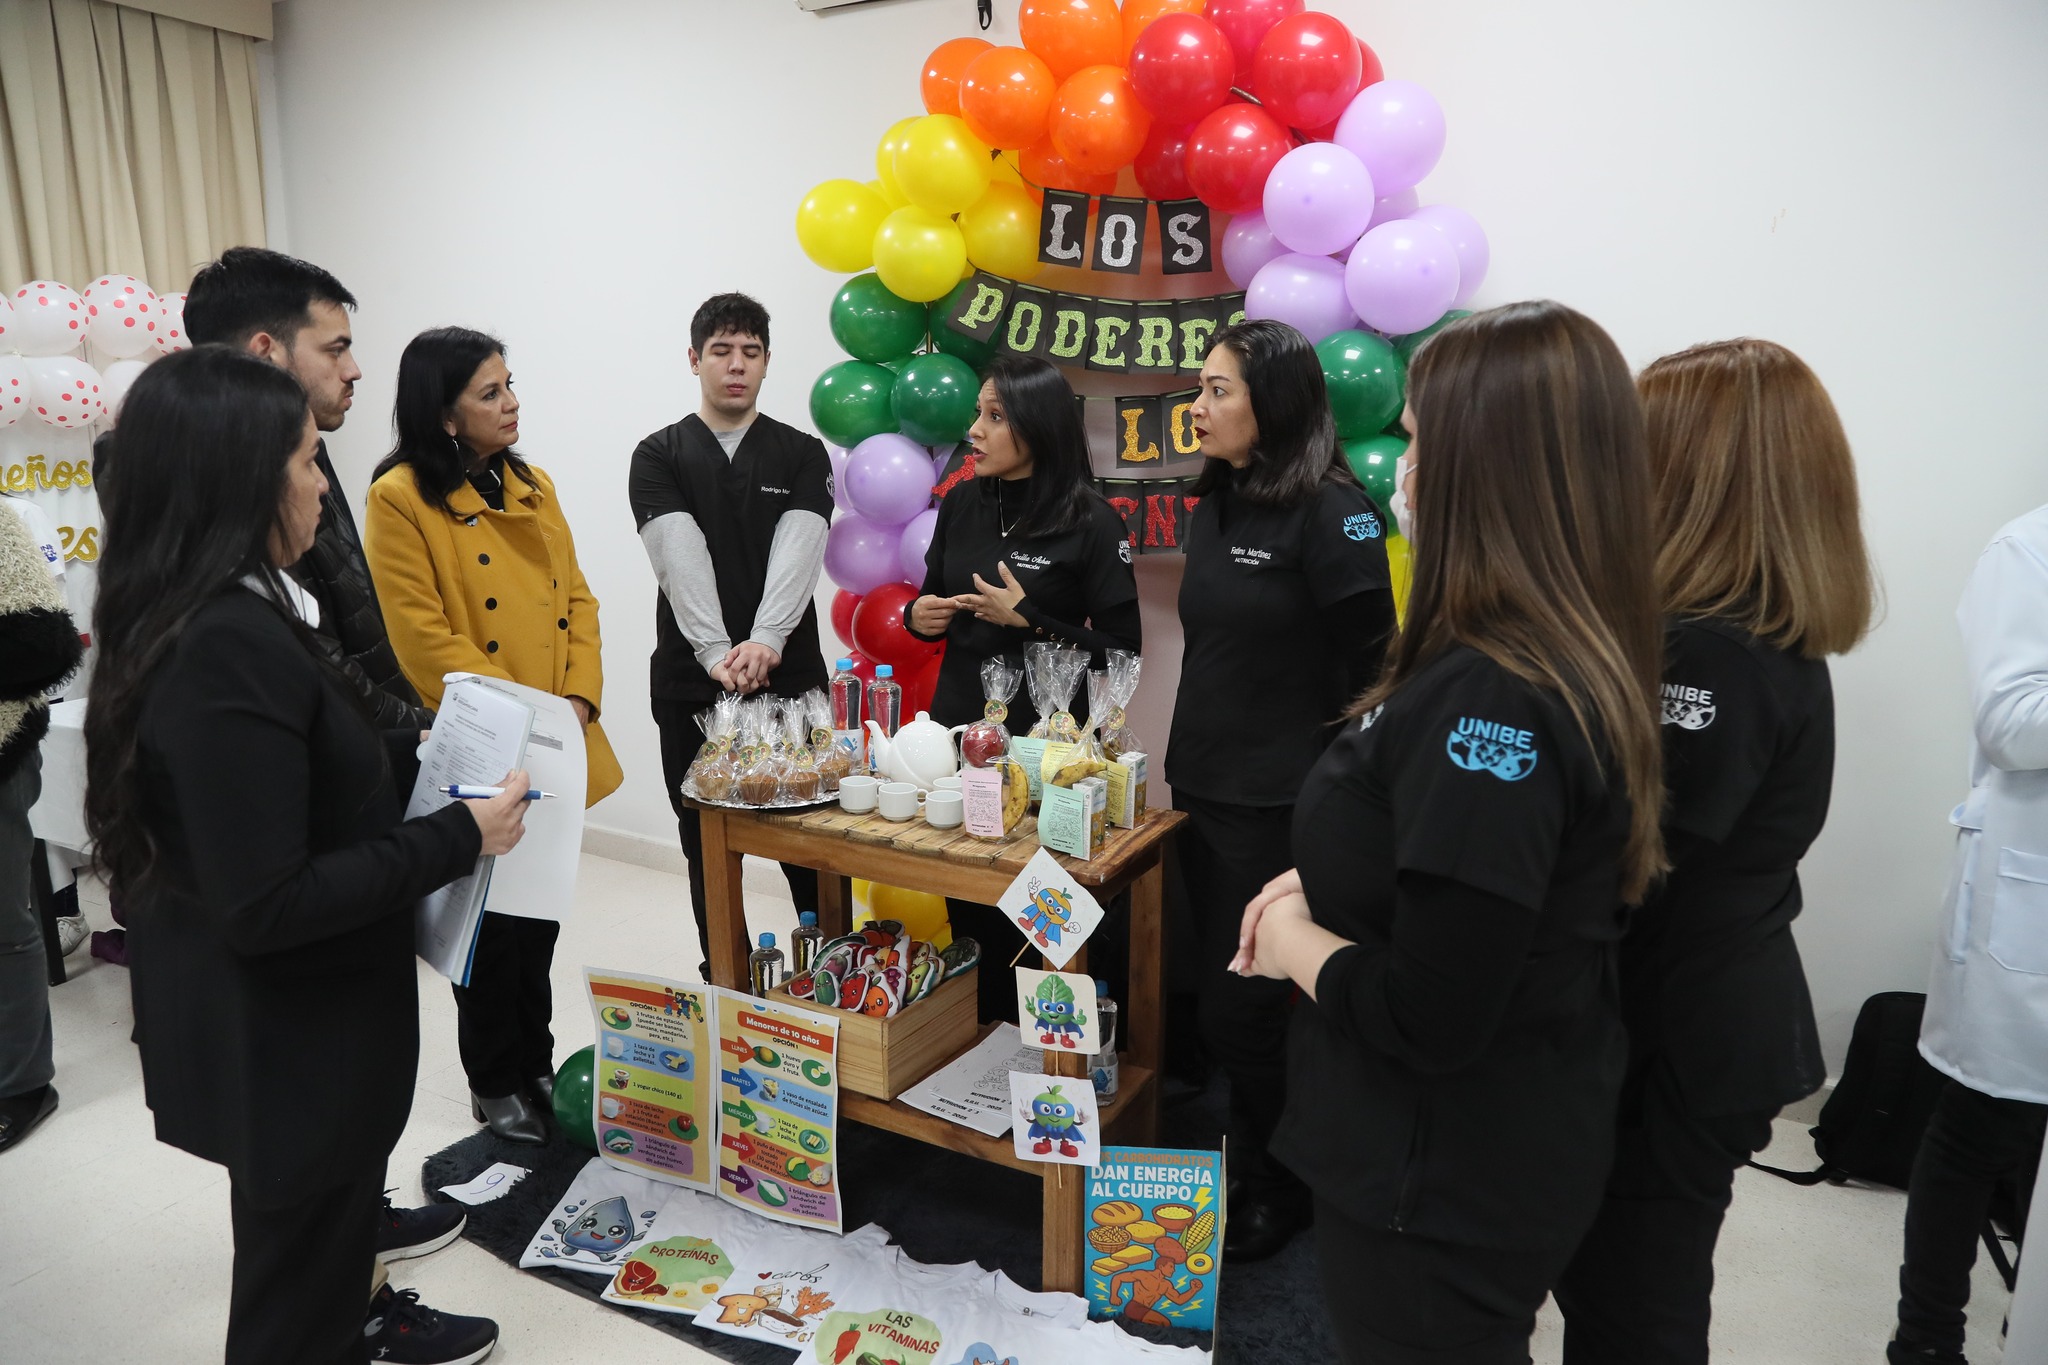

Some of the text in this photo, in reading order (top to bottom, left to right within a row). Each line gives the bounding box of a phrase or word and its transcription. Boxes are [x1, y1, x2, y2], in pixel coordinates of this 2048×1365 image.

[1045, 202, 1204, 267] LOS
[1121, 402, 1201, 463] LO
[1344, 512, 1375, 525] UNIBE
[1456, 716, 1534, 750] UNIBE
[746, 1017, 820, 1045] Menores de 10 años
[732, 1045, 748, 1054] LUNES
[773, 1037, 795, 1048] OPCIÓN
[786, 1054, 800, 1062] huevo
[637, 1084, 651, 1092] yogur
[732, 1076, 750, 1086] MARTES
[789, 1098, 803, 1108] frutas
[806, 1098, 827, 1109] ensalada
[732, 1140, 749, 1151] JUEVES
[1114, 1152, 1213, 1168] CARBOHIDRATOS
[728, 1173, 748, 1185] VIERNES
[1091, 1165, 1213, 1186] DAN ENERGÍA
[1092, 1182, 1192, 1201] AL CUERPO
[650, 1245, 720, 1265] PROTEÍNAS
[886, 1312, 913, 1329] LAS
[868, 1323, 940, 1354] VITAMINAS
